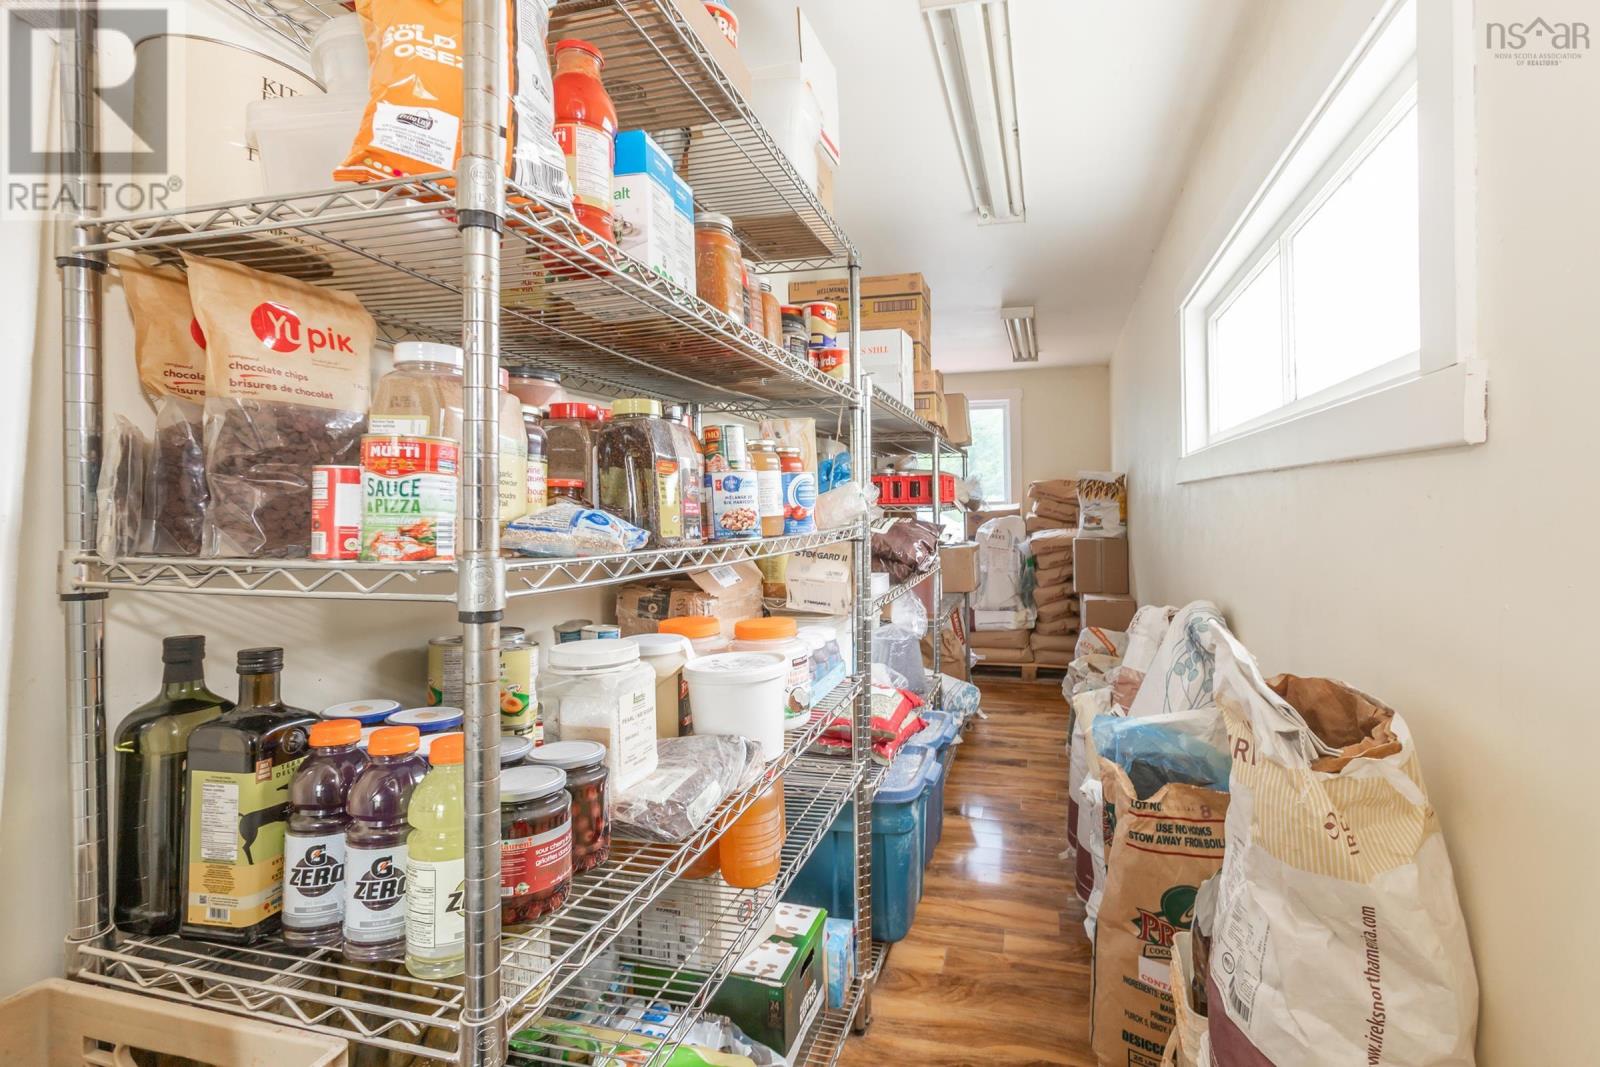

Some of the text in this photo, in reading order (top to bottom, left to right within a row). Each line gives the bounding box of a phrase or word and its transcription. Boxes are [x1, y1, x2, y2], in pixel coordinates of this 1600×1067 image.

[613, 187, 630, 200] alt
[228, 361, 309, 382] chocolate chips
[229, 378, 334, 400] brisures de chocolat
[370, 445, 420, 458] MUTTI
[367, 477, 421, 497] SAUCE
[375, 498, 421, 513] PIZZA
[1131, 800, 1148, 811] LOT
[1156, 823, 1174, 834] USE
[1175, 824, 1188, 835] NO
[1128, 830, 1154, 843] STOW
[1156, 834, 1182, 846] AWAY
[290, 863, 344, 888] ZERO
